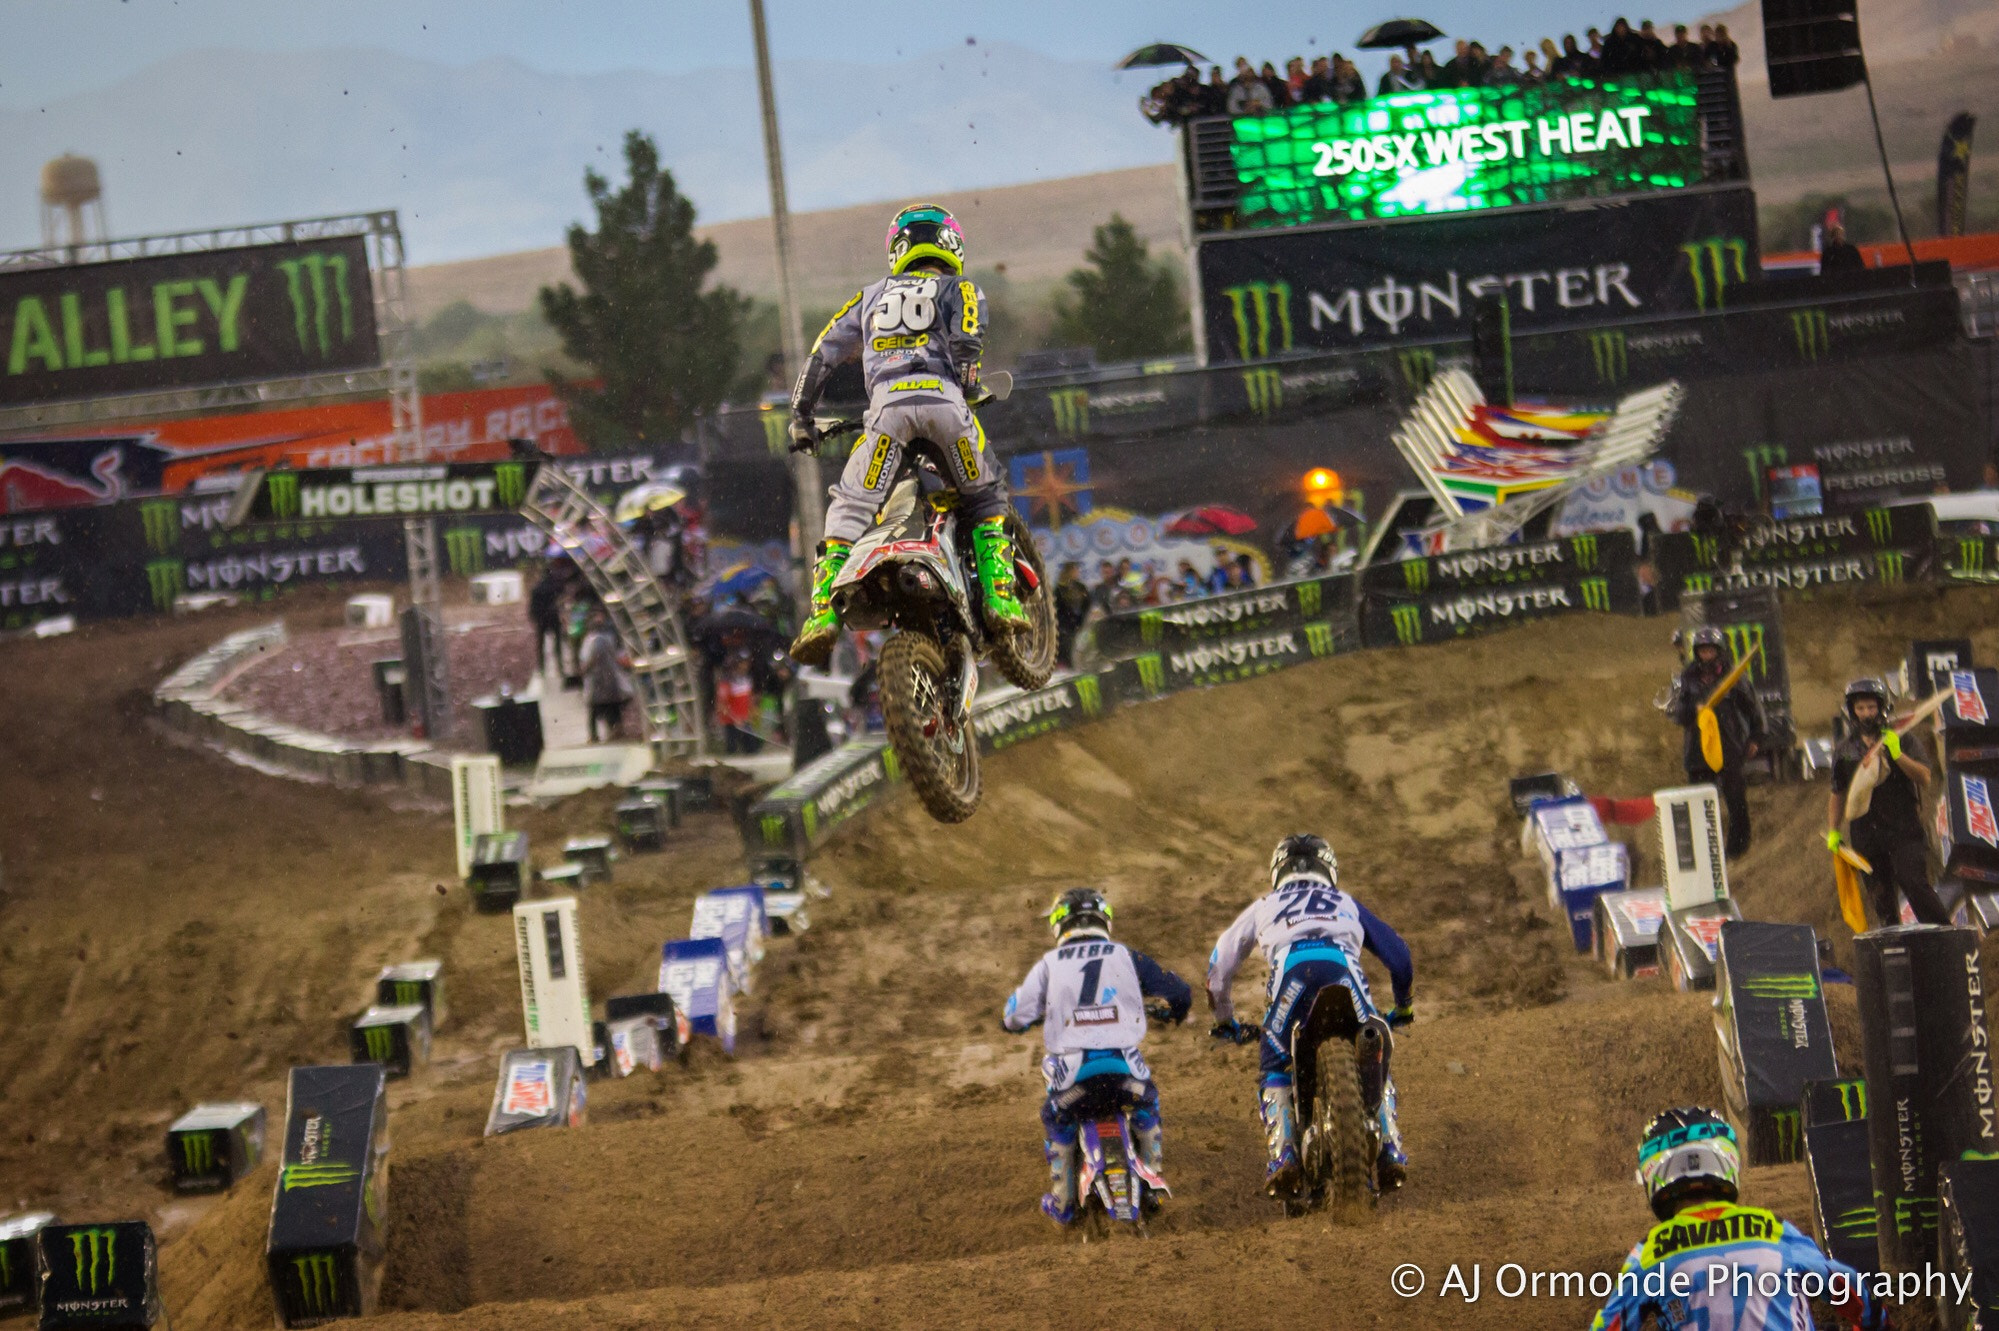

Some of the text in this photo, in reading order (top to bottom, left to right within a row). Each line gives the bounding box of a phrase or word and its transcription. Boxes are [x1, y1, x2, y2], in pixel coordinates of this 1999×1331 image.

[1311, 106, 1651, 177] 250SX WEST HEAT
[7, 273, 250, 376] ALLEY
[873, 278, 938, 331] 58
[959, 280, 979, 335] GEICO
[873, 333, 929, 352] GEICO
[864, 434, 891, 490] GEICO
[876, 442, 899, 492] HONDA
[949, 444, 968, 484] HONDA
[957, 437, 979, 481] GEICO
[300, 476, 496, 517] HOLESHOT
[186, 547, 367, 588] MONSTER
[1437, 544, 1564, 578] MONSTER
[1430, 586, 1571, 625] MONSTER
[1170, 631, 1298, 675] MONSTER
[1273, 890, 1343, 924] 26
[1057, 944, 1115, 961] WEBB
[1078, 958, 1104, 1007] 1
[1789, 999, 1809, 1048] MONSTER
[1966, 949, 1995, 1138] MONSTER
[1896, 1096, 1916, 1192] MONSTER
[1914, 1112, 1925, 1177] ENERGY
[1652, 1213, 1774, 1260] SAVATGY
[57, 1299, 129, 1312] MONSTER
